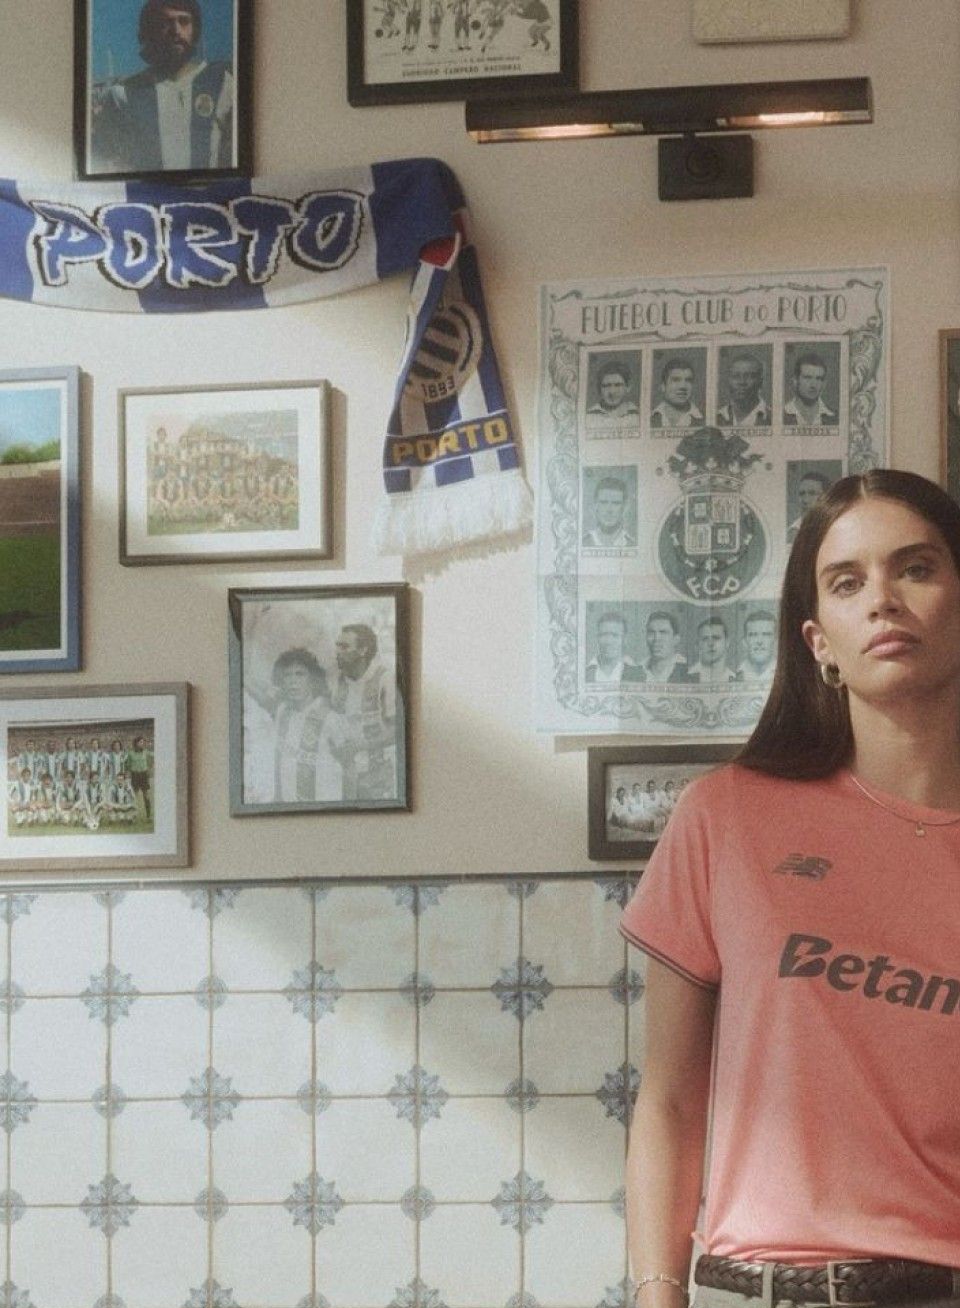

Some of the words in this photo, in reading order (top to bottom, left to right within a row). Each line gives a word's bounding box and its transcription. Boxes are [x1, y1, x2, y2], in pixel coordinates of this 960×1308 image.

[29, 189, 366, 289] PORTO
[581, 302, 671, 334] FUTEBOL
[682, 297, 733, 325] CLUB
[777, 294, 847, 323] PORTO
[392, 418, 508, 465] PORTO
